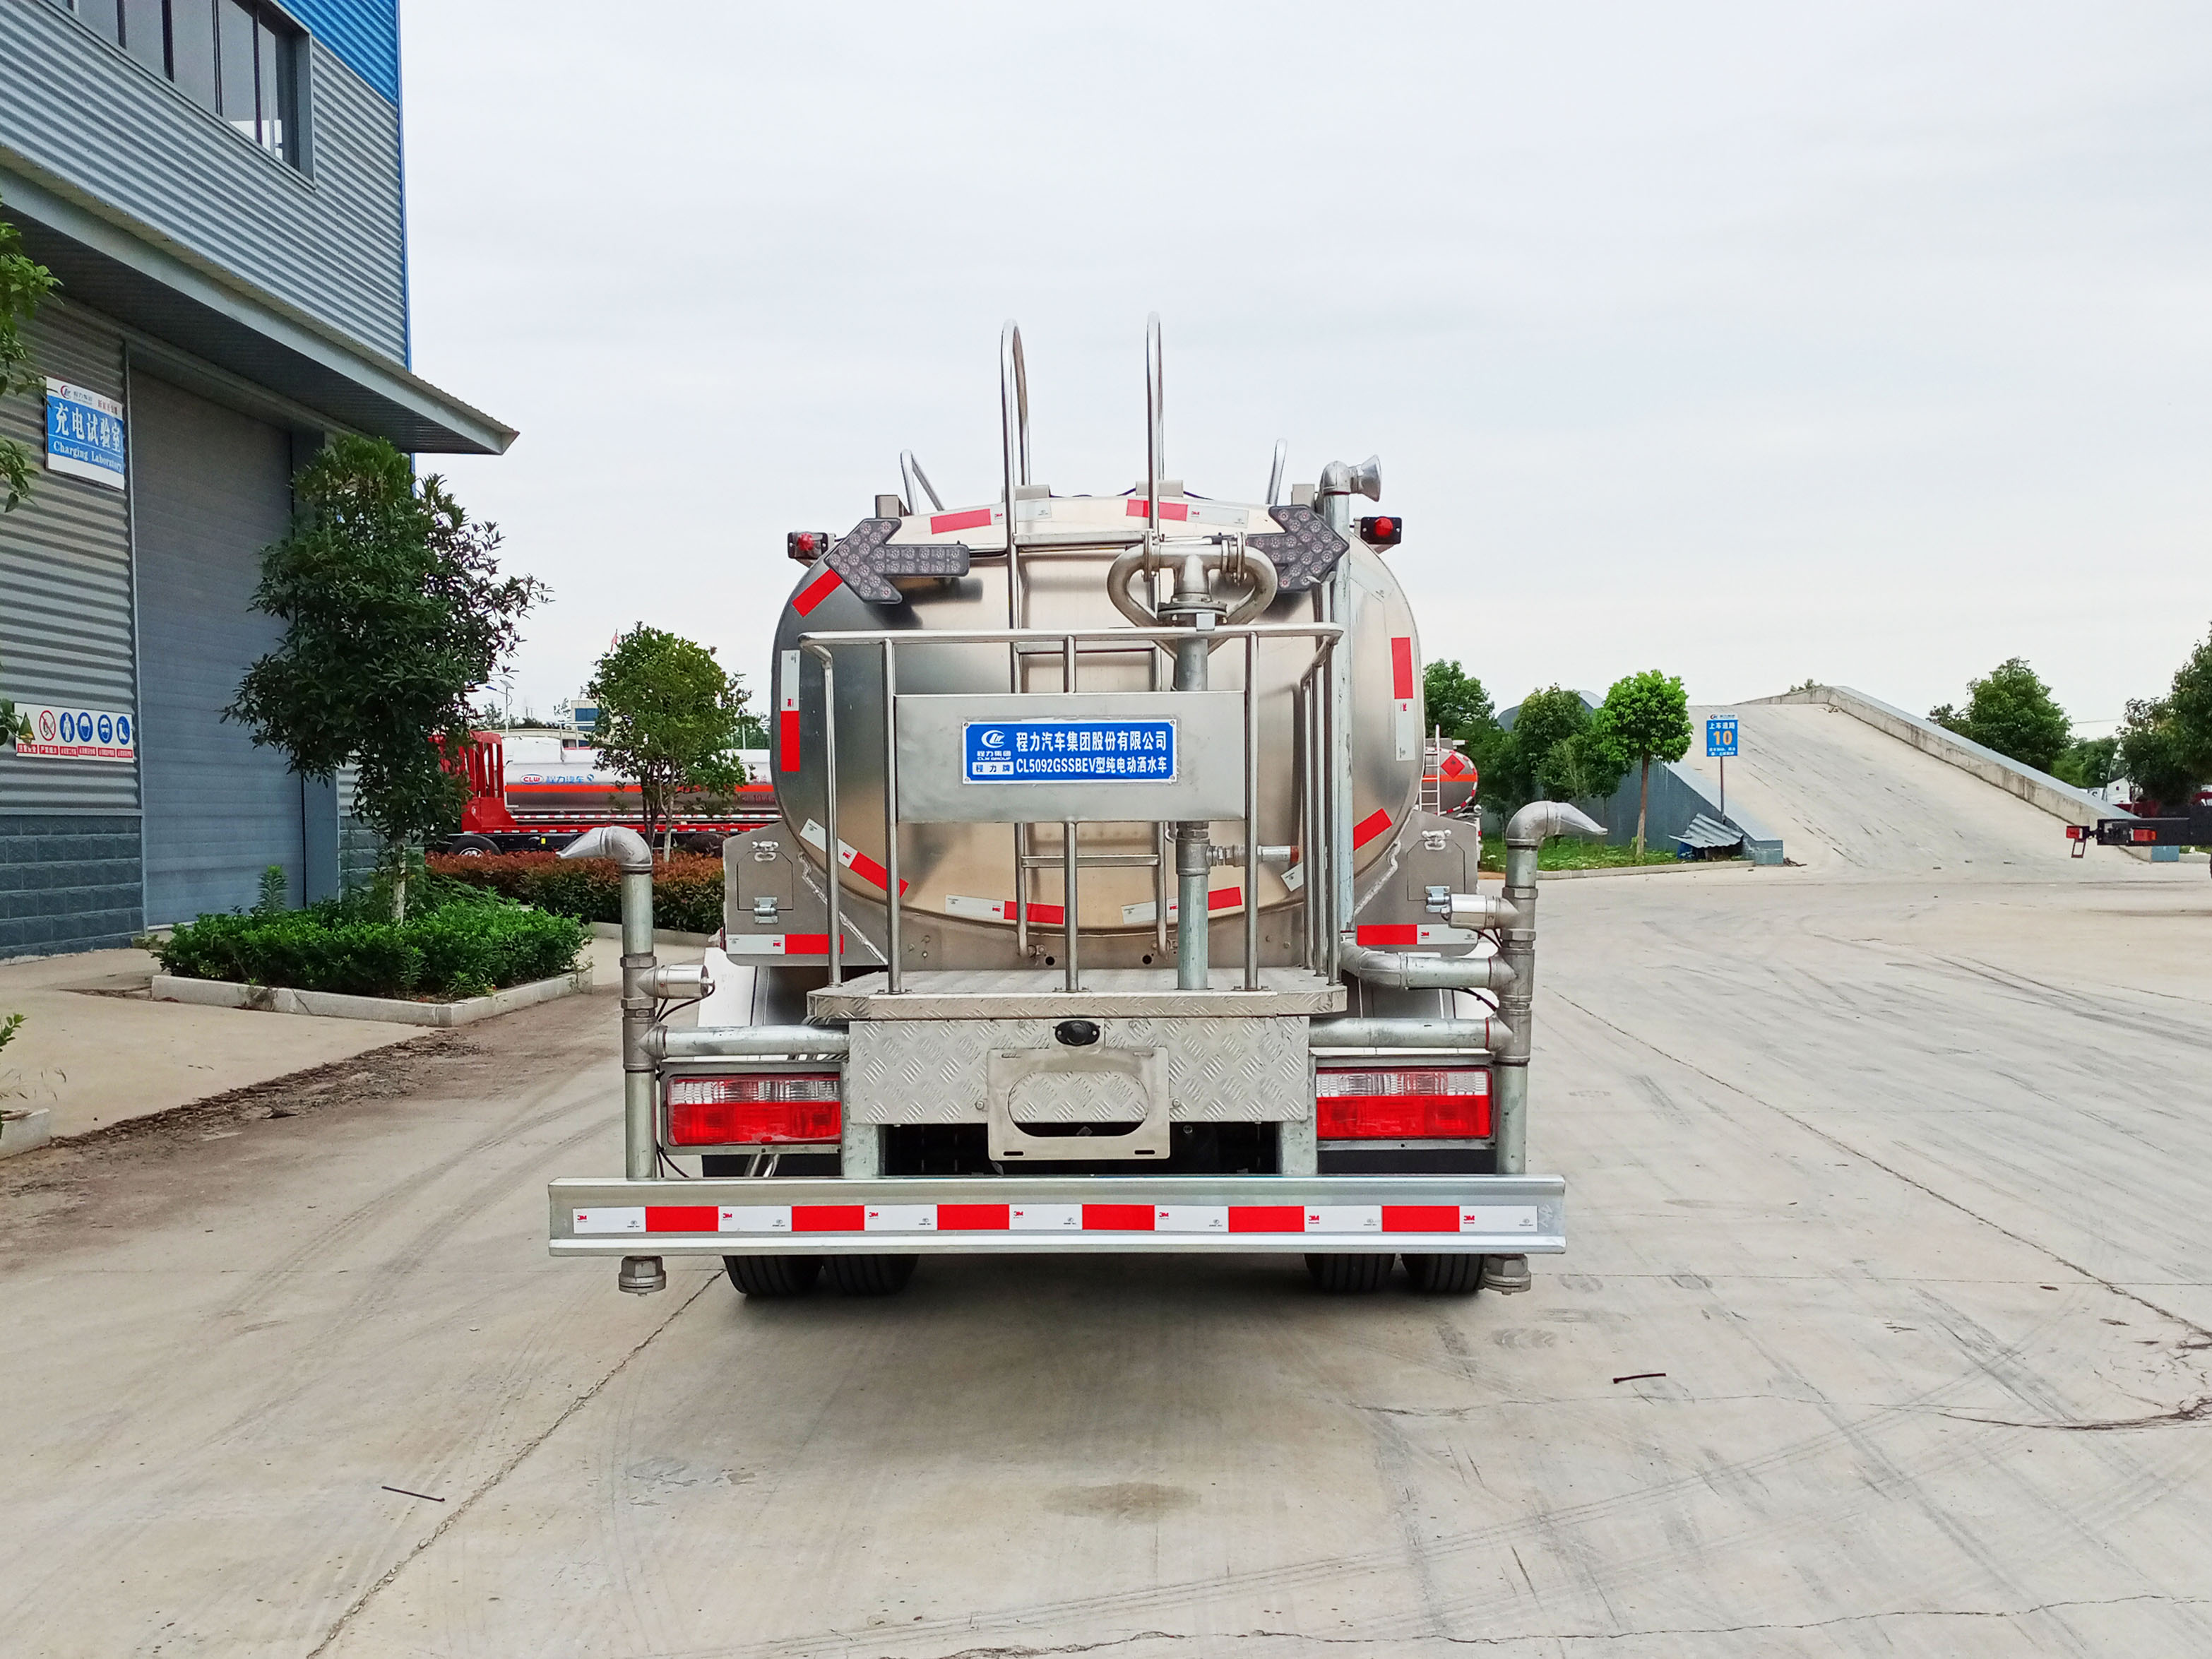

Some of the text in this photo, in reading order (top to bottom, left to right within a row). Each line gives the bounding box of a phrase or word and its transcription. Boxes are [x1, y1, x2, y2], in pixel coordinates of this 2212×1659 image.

[54, 402, 121, 453] 充电试验室
[53, 440, 89, 461] Charging
[1016, 730, 1167, 752] 程力汽车集团股份有限公司
[1713, 730, 1733, 745] 10
[1016, 756, 1167, 773] CL5092GSSBEV型纯电动洒水车
